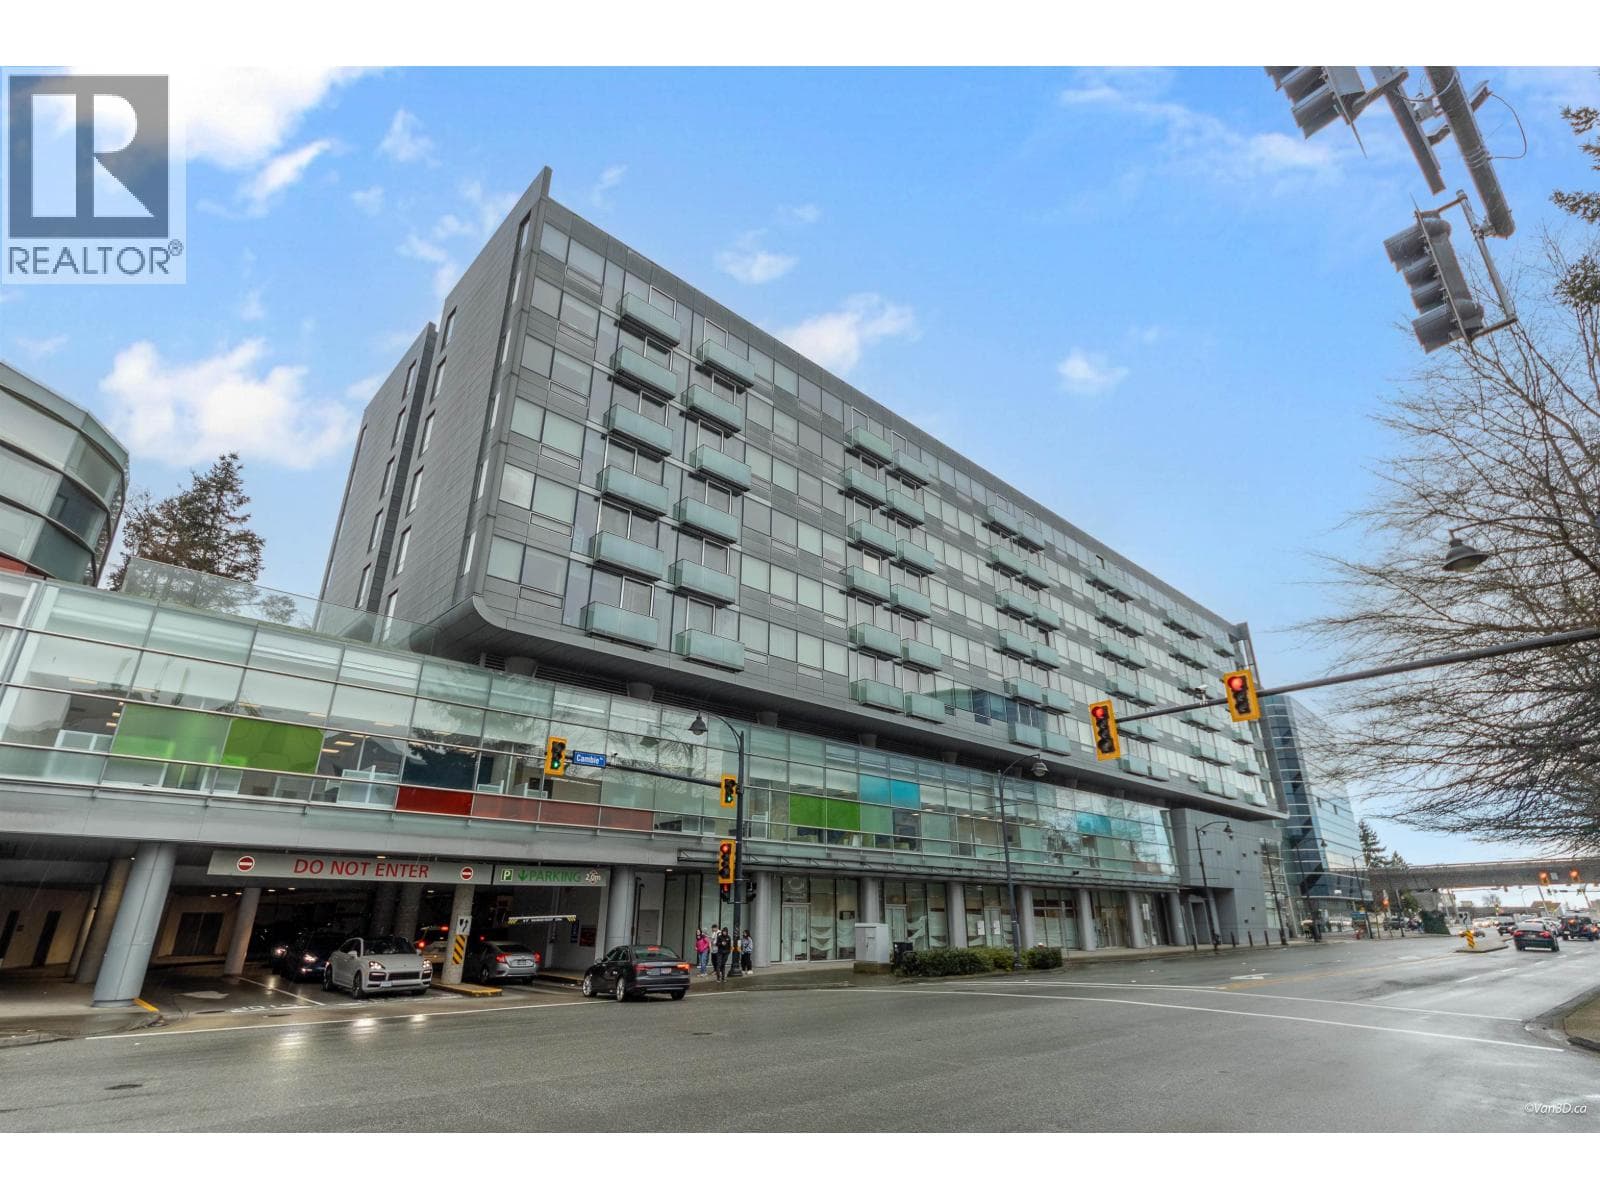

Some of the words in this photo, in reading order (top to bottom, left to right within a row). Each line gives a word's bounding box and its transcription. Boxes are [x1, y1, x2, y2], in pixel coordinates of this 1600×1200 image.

[576, 754, 600, 765] Cambie
[293, 858, 324, 875] DO
[330, 861, 370, 876] NOT
[374, 862, 429, 879] ENTER
[503, 870, 511, 879] P
[529, 870, 581, 882] PARKING
